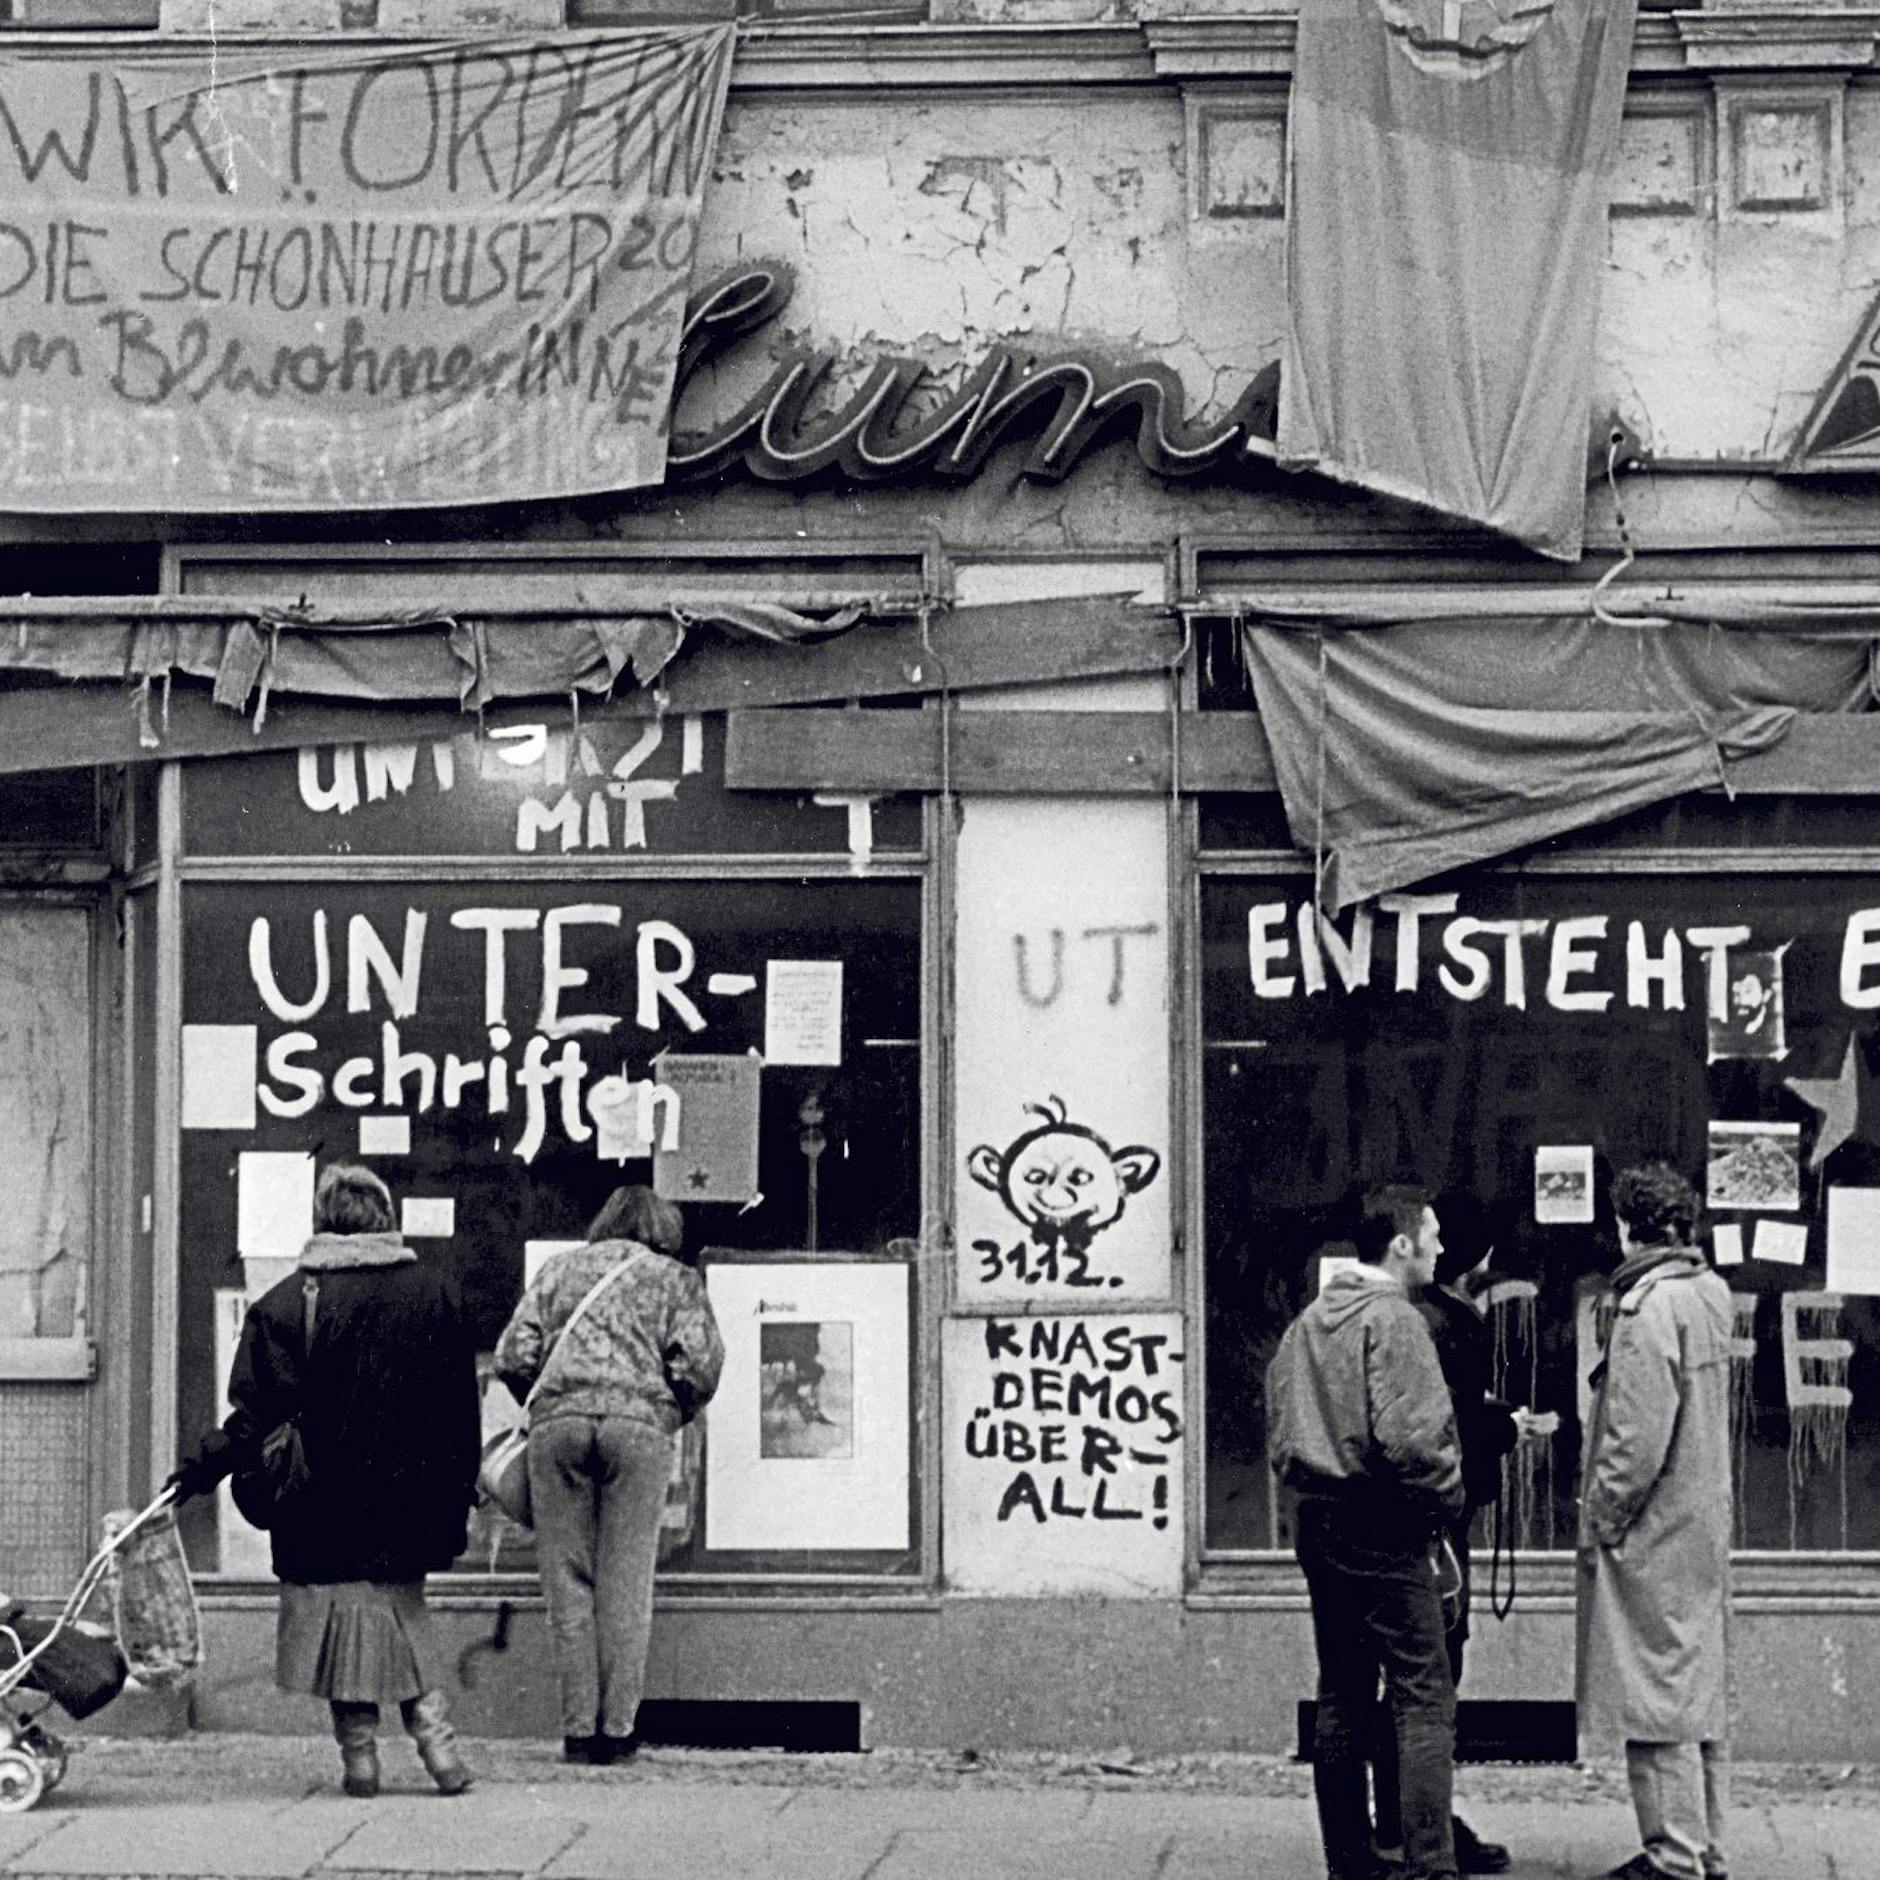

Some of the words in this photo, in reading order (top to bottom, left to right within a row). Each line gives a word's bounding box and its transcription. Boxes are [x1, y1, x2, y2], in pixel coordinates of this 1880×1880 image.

[516, 779, 680, 851] MIT
[249, 903, 757, 1039] UNTER-
[1247, 893, 1752, 1022] ENTSTEHT
[257, 1020, 680, 1163] Schriften
[985, 1315, 1186, 1376] KNAST-
[965, 1407, 1168, 1476] ÜBER-
[993, 1368, 1182, 1443] DEMOS
[997, 1471, 1168, 1530] ALL!
